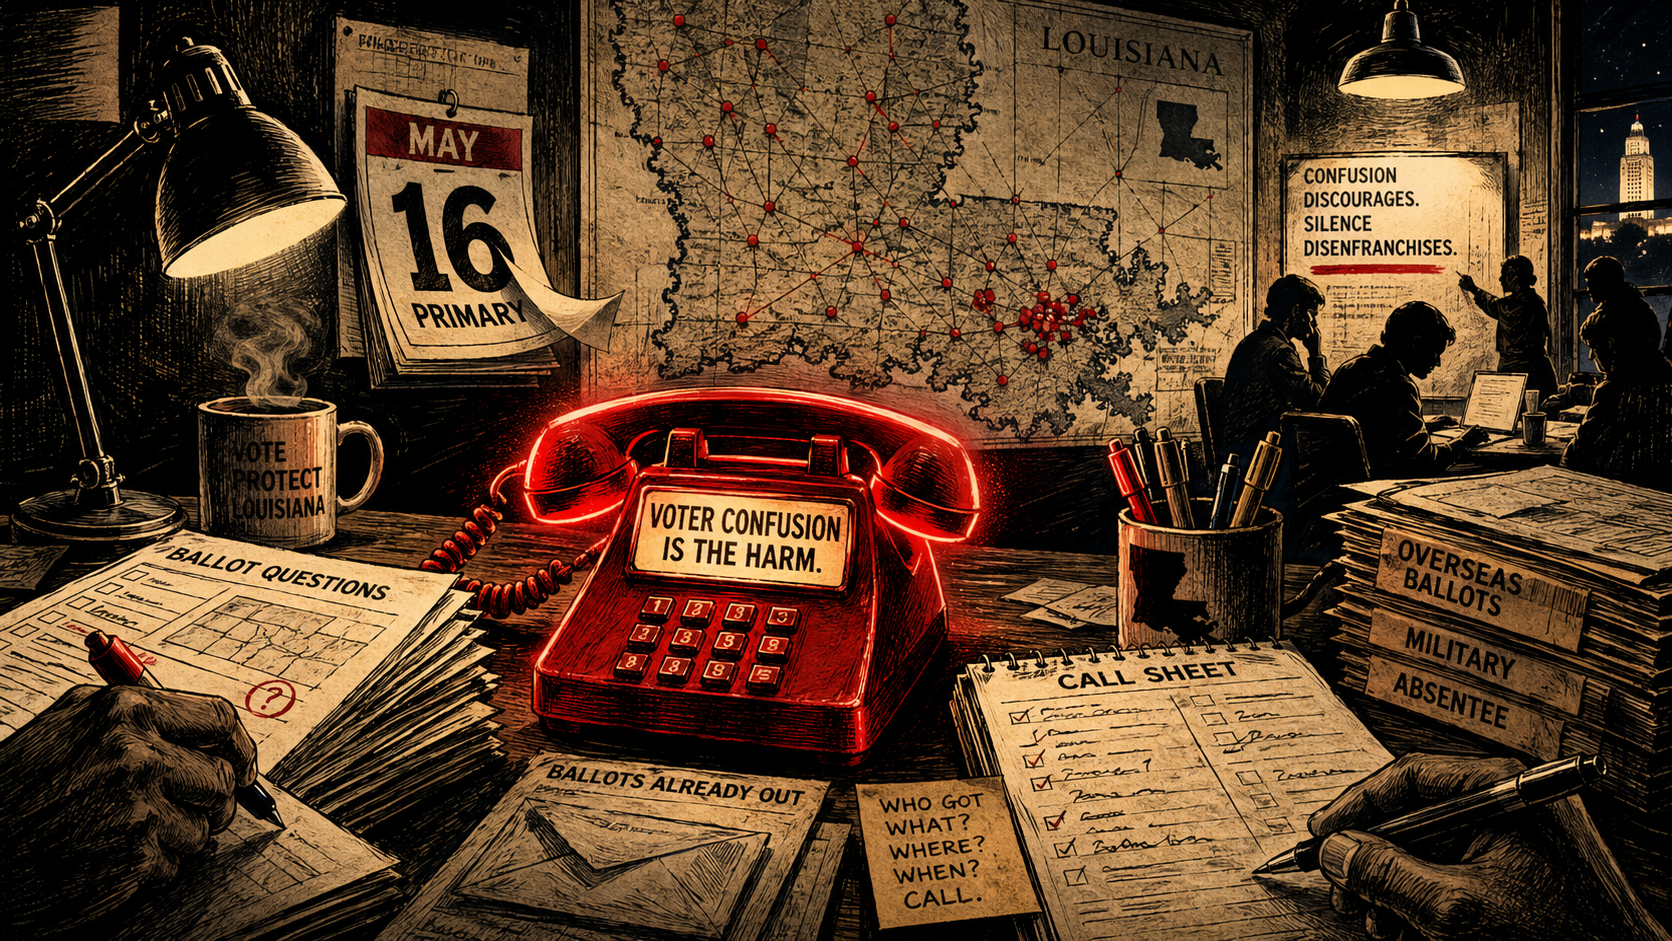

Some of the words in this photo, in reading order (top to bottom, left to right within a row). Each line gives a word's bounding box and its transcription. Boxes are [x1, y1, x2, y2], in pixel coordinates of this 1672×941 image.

[1042, 26, 1223, 76] LOUISIANA
[408, 122, 479, 162] MAY
[1304, 167, 1397, 184] CONFUSION
[1304, 190, 1420, 208] DISCOURAGES.
[1304, 215, 1372, 232] SILENCE
[391, 181, 515, 293] 16
[1304, 239, 1458, 257] DISENFRANCHISES.
[411, 302, 526, 328] PRIMARY
[232, 441, 286, 463] VOTE
[232, 467, 322, 491] PROTECT
[232, 495, 326, 519] LOUISIANA
[650, 502, 714, 533] VOTER
[721, 507, 841, 543] CONFUSION
[662, 536, 685, 561] IS
[693, 538, 737, 567] THE
[746, 543, 822, 574] HARM.
[1398, 539, 1524, 596] OVERSEAS
[166, 547, 262, 575] BALLOT
[261, 565, 391, 601] QUESTIONS
[1404, 568, 1502, 616] BALLOTS
[1406, 627, 1516, 680] MILITARY
[1057, 669, 1135, 691] CALL
[1147, 661, 1238, 683] SHEET
[1393, 672, 1508, 731] ABSENTEE
[546, 763, 647, 789] BALLOTS
[650, 775, 754, 801] ALREADY
[758, 787, 806, 807] OUT
[878, 796, 931, 814] WHO
[941, 791, 984, 809] GOT
[885, 813, 971, 836] WHAT?
[888, 835, 985, 859] WHERE?
[893, 859, 979, 883] WHEN?
[905, 886, 981, 908] CALL.
